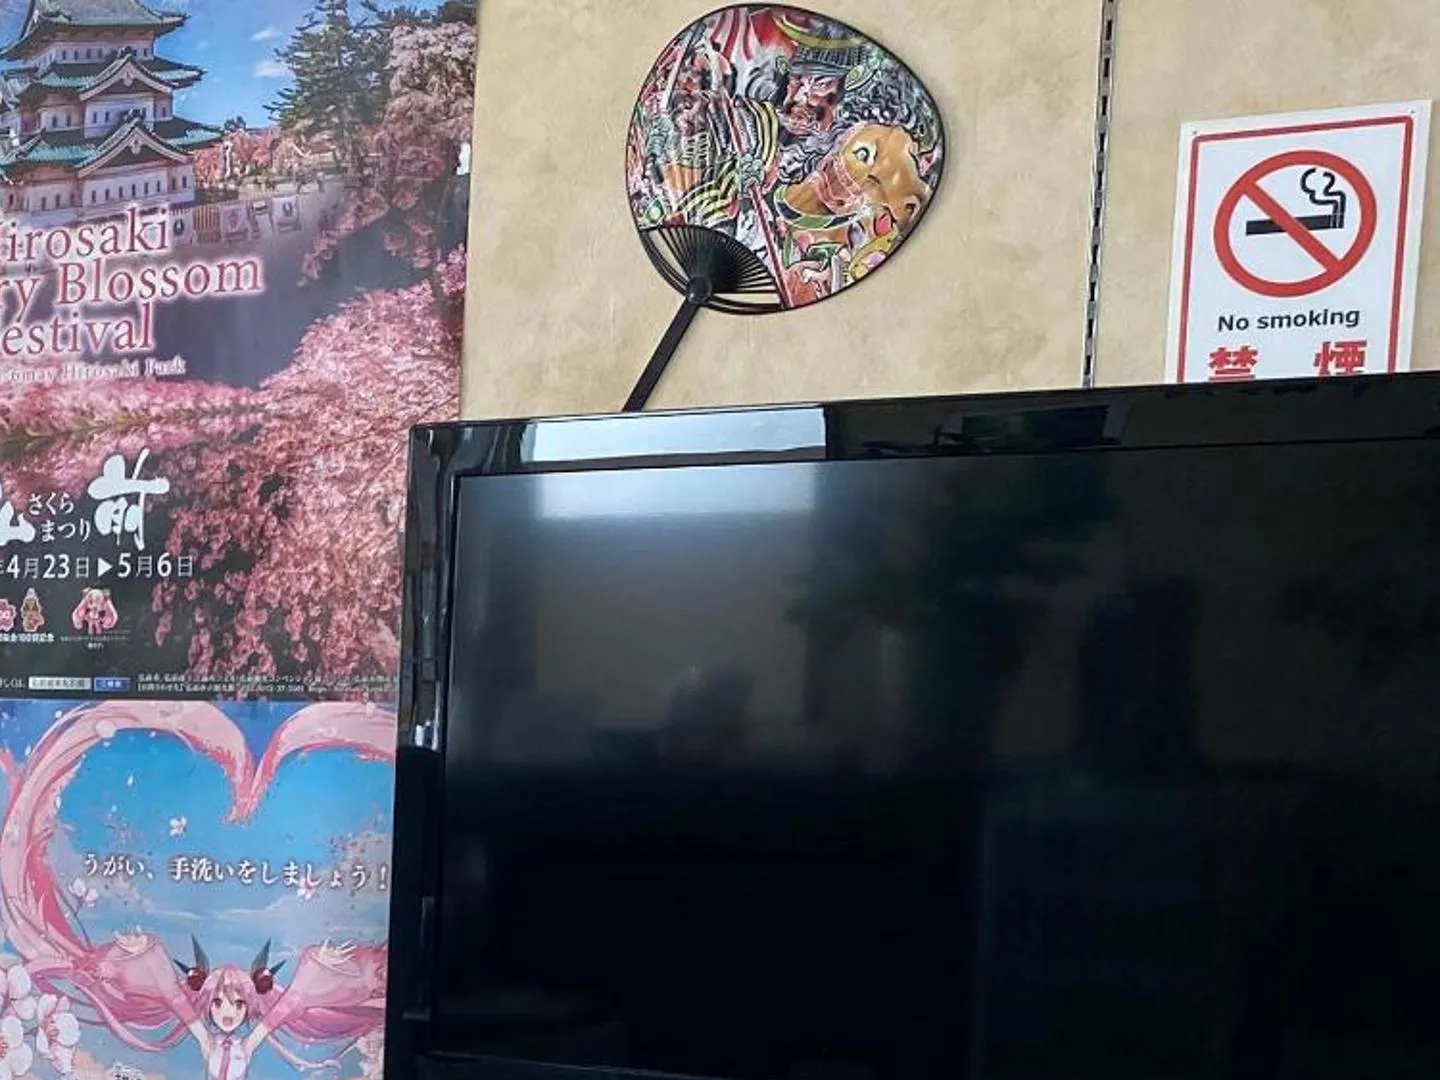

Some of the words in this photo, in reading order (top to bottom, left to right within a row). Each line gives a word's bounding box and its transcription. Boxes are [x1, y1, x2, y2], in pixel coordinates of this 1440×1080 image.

[59, 258, 262, 306] Blossom
[1218, 315, 1250, 332] No
[1257, 309, 1361, 331] smoking
[28, 492, 75, 515] さくら
[40, 520, 92, 543] まつり
